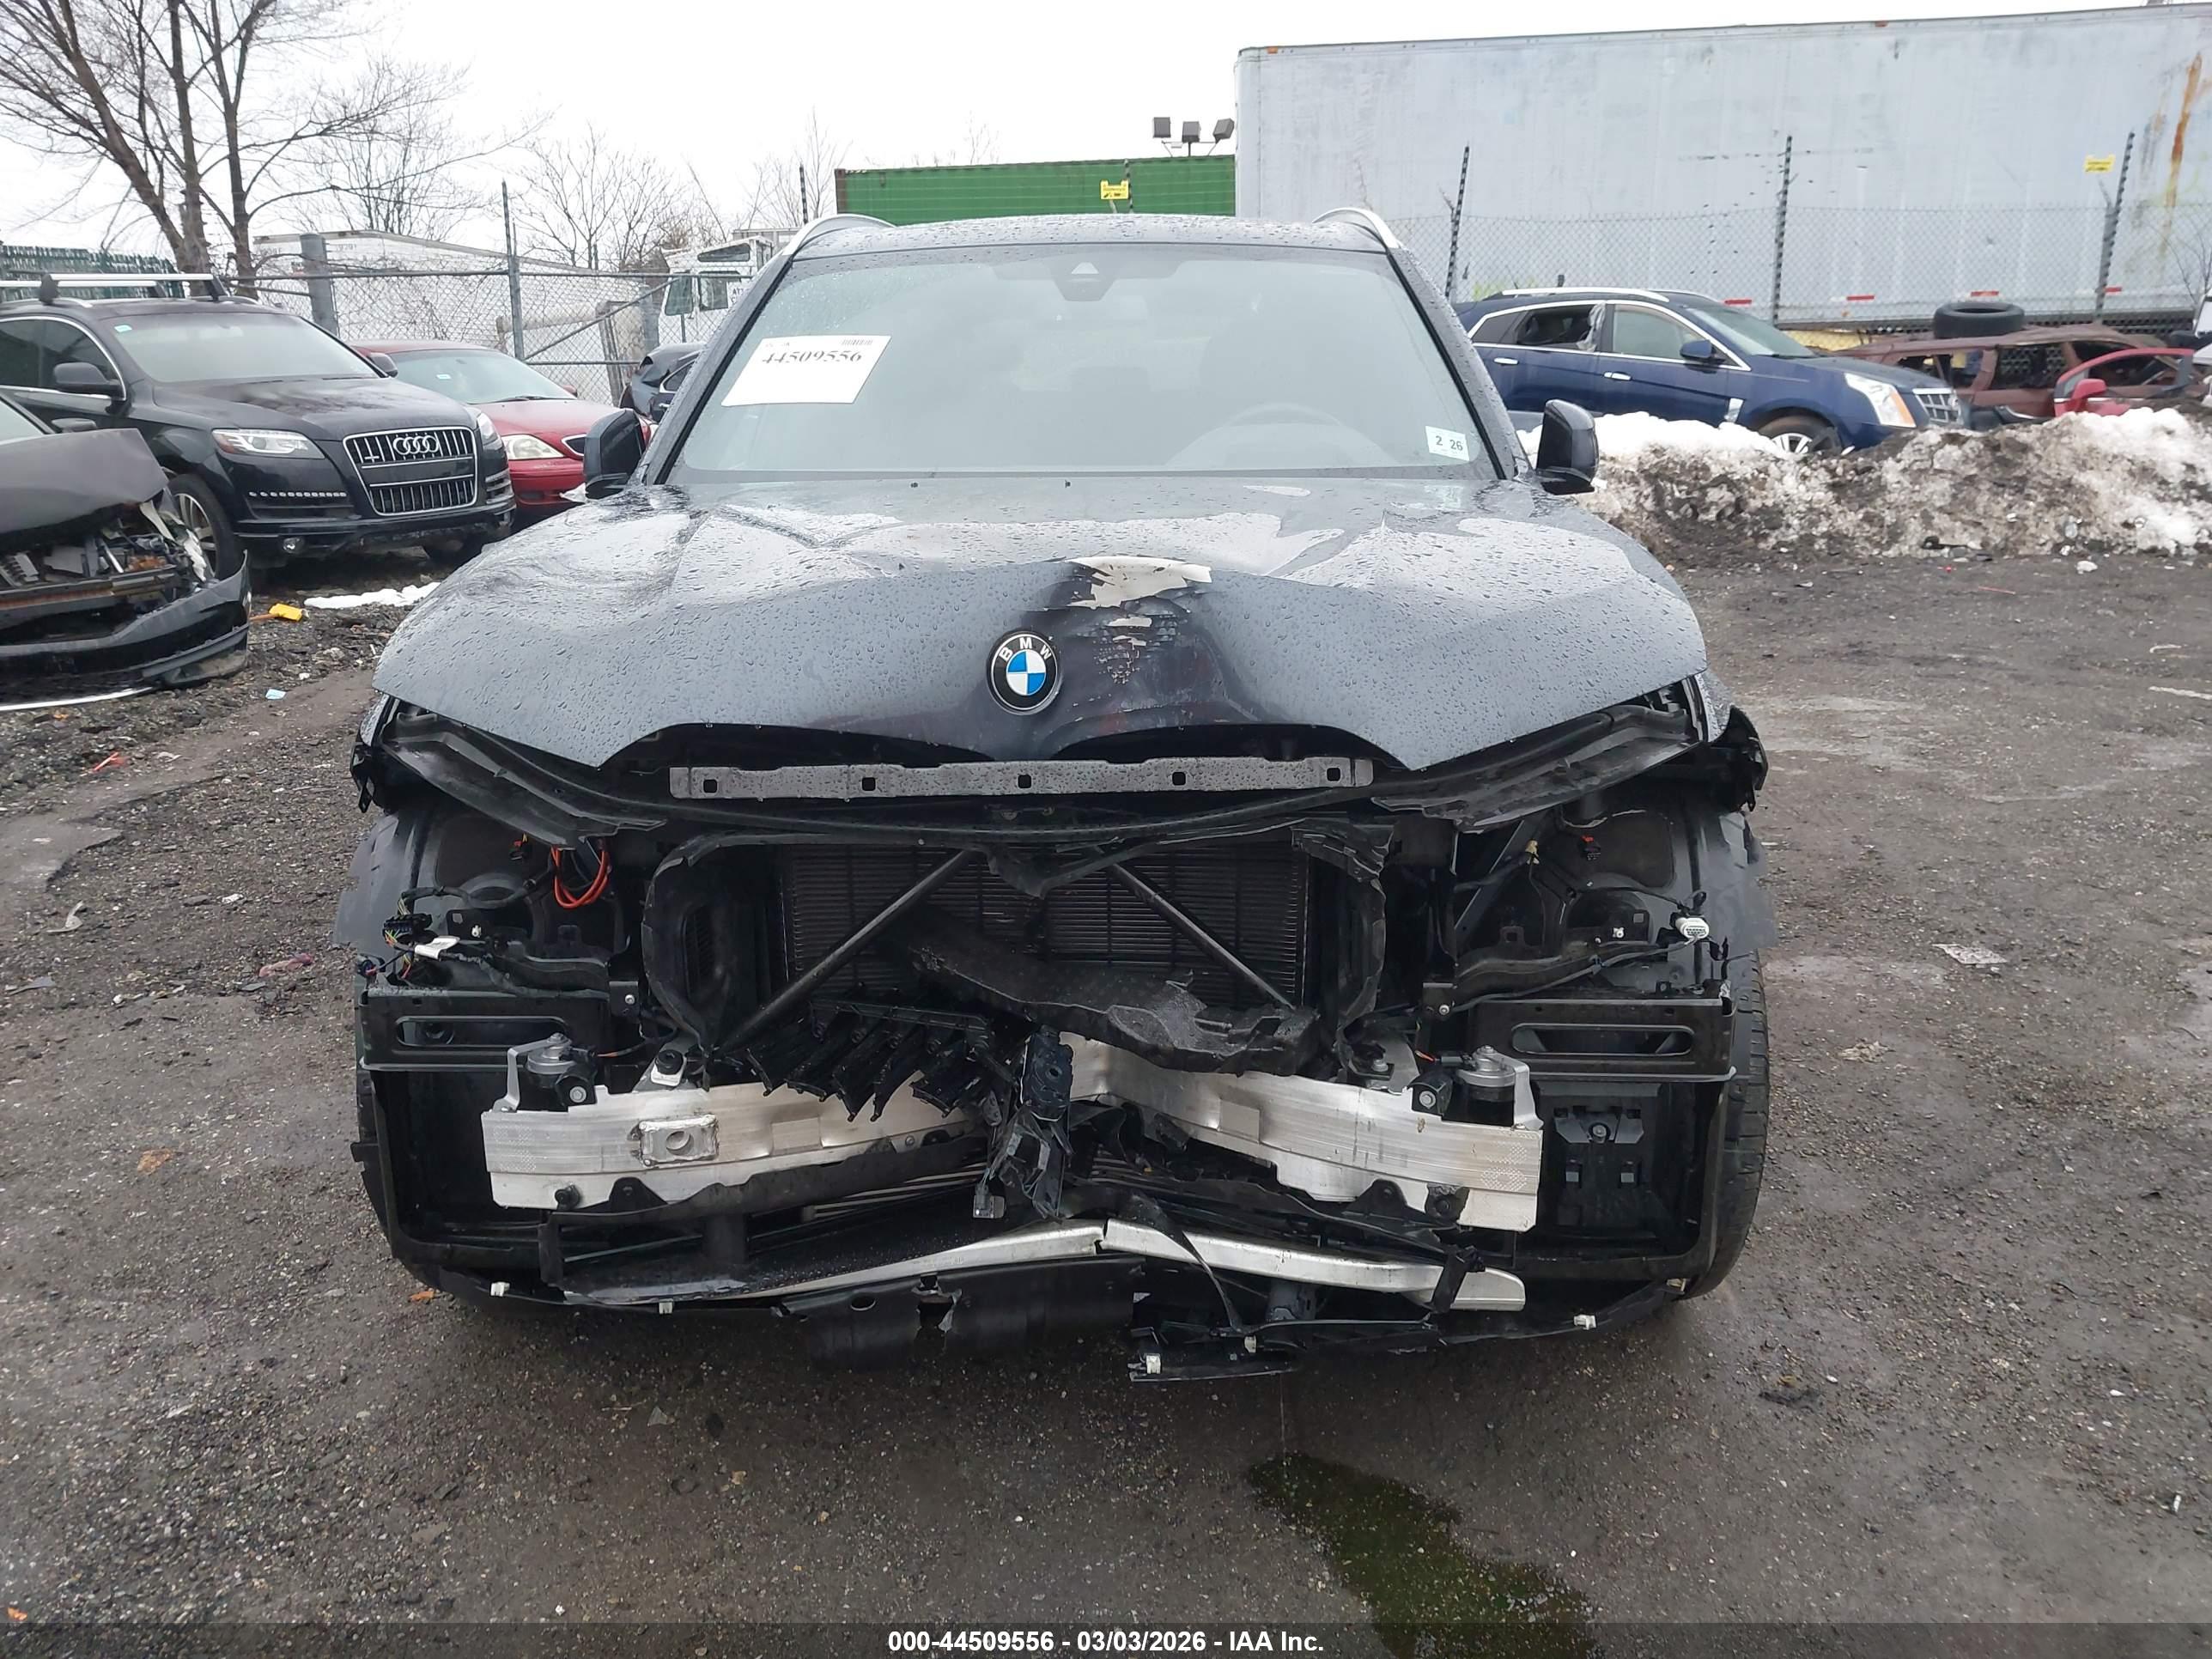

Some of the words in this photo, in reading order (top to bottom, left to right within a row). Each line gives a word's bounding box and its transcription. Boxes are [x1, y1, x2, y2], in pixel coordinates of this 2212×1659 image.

[762, 349, 863, 364] 44509556
[1435, 435, 1443, 447] 2
[1449, 439, 1463, 452] 26
[999, 636, 1052, 662] BMW
